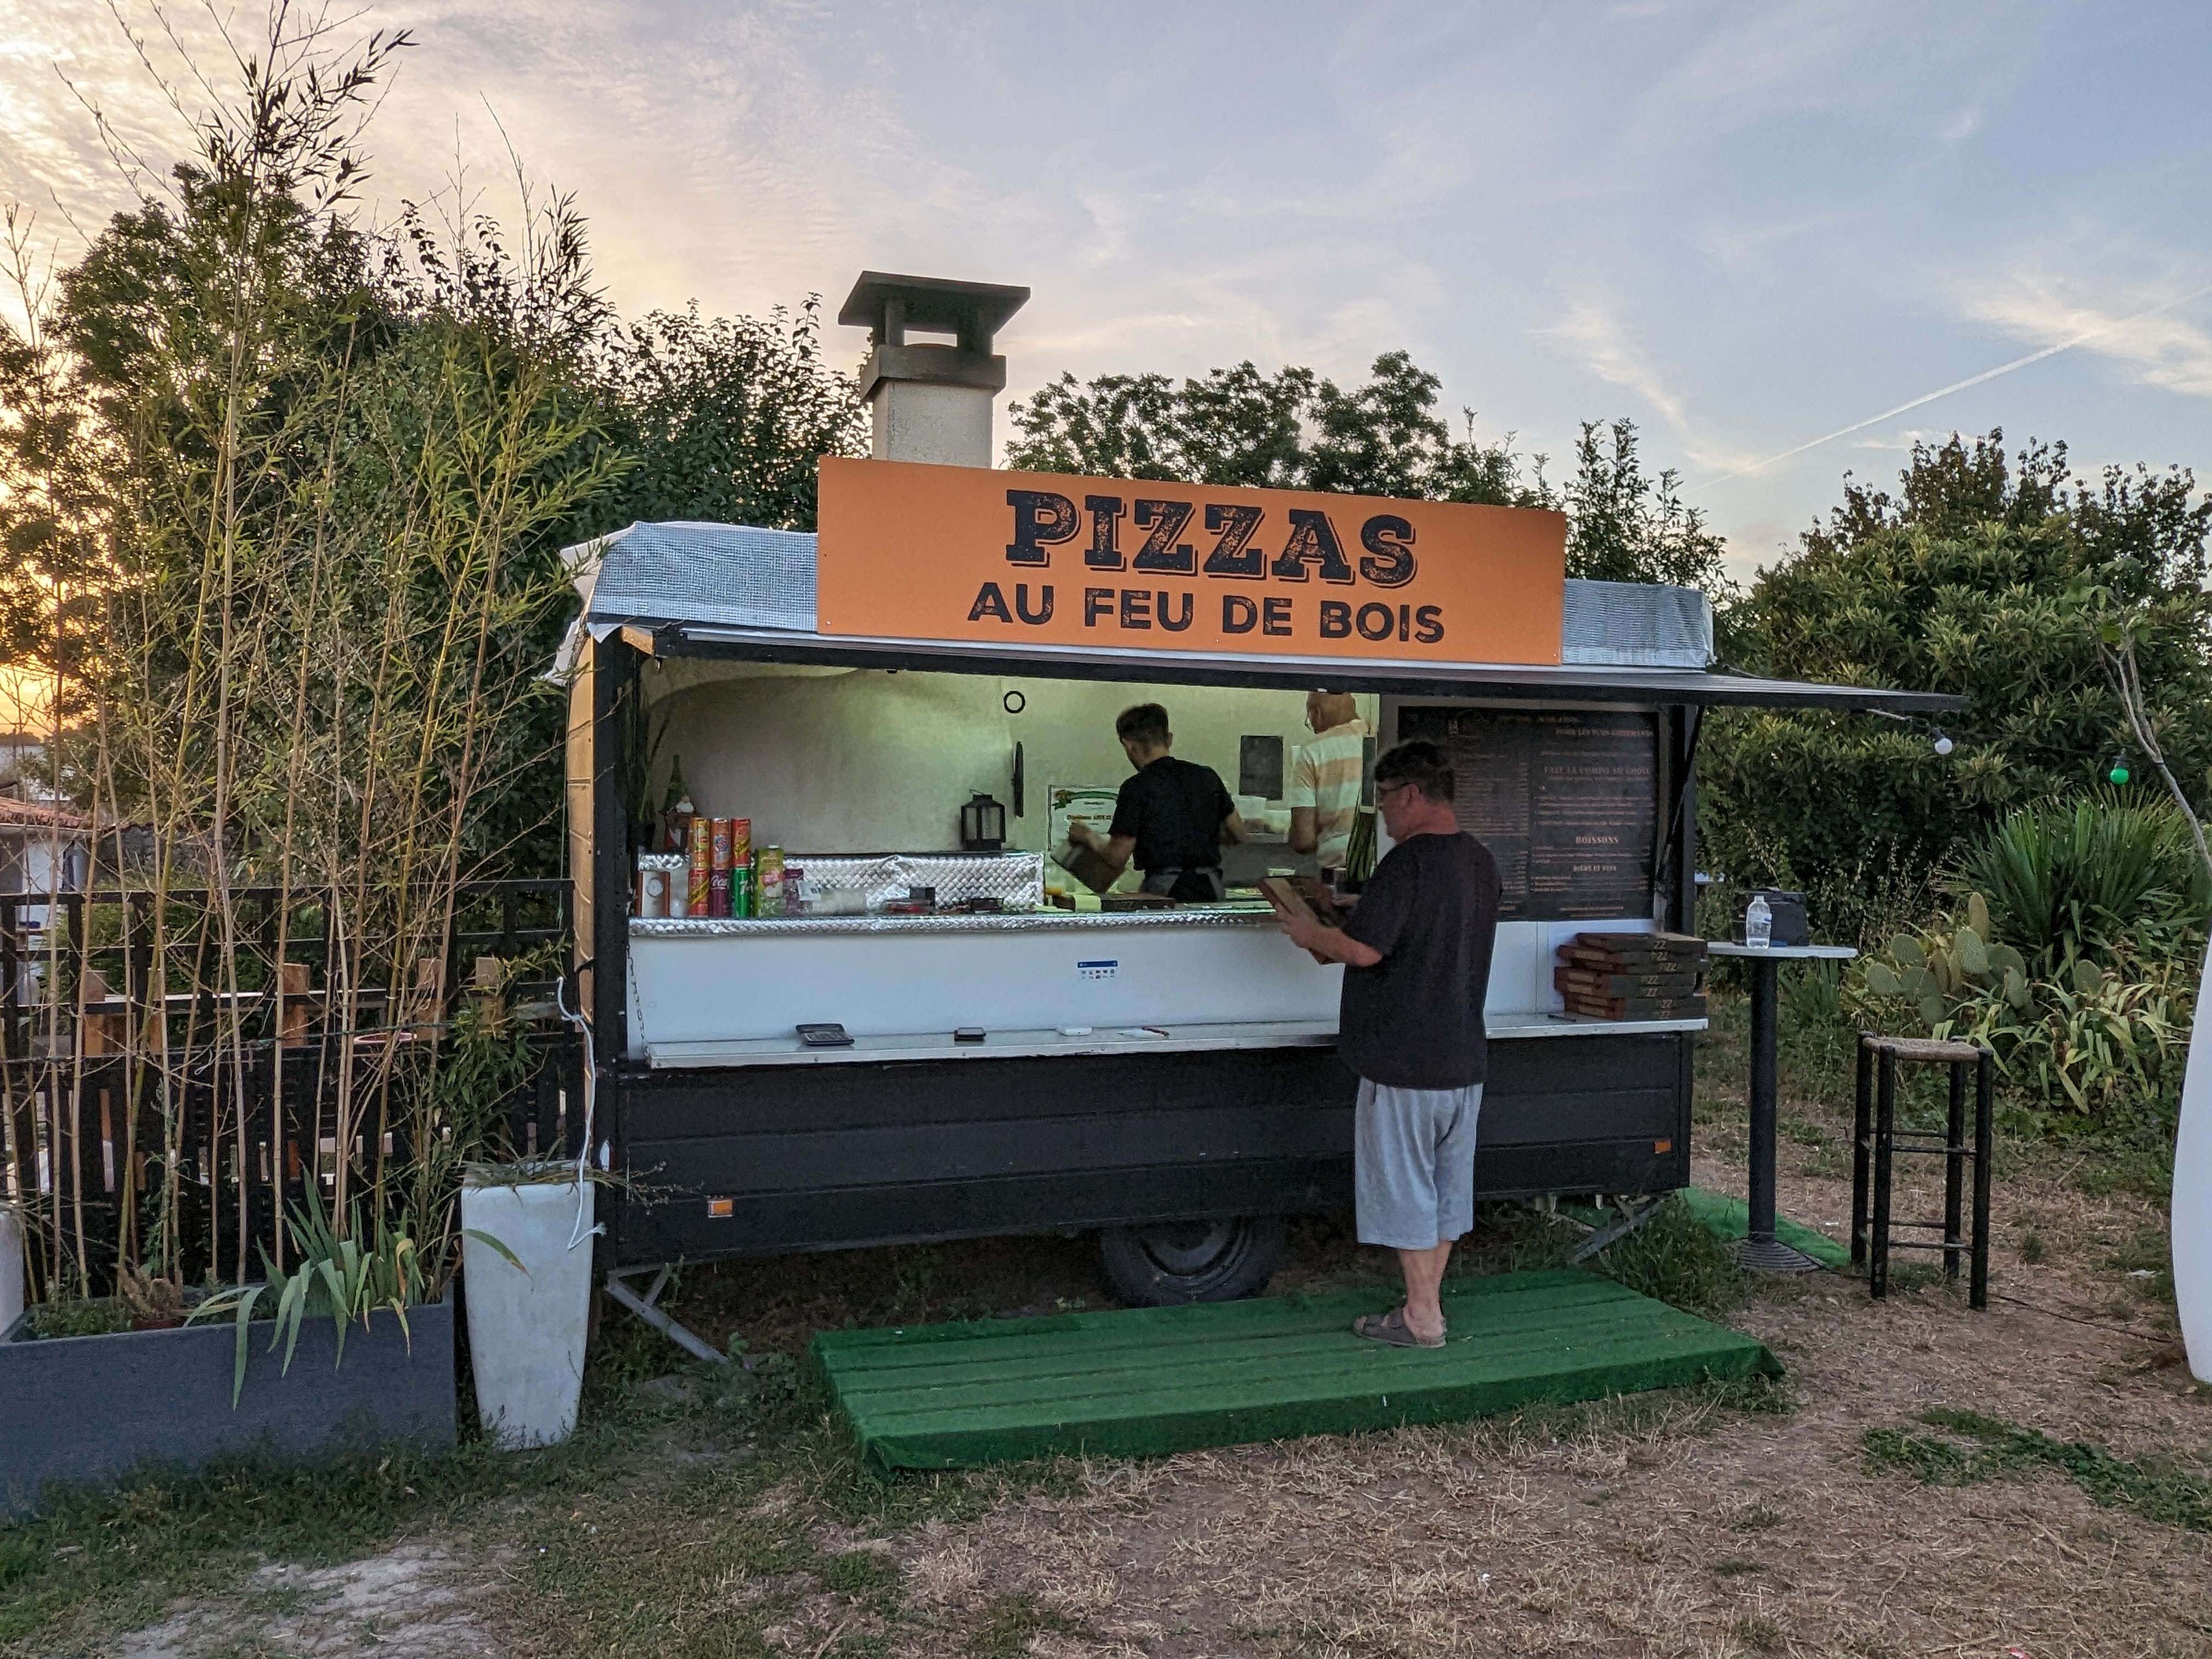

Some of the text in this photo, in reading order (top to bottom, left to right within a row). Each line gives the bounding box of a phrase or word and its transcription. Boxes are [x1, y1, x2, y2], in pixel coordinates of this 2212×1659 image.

[1006, 489, 1418, 588] PIZZAS
[967, 582, 1445, 644] AU FEU DE BOIS
[1576, 836, 1618, 844] BOISSONS
